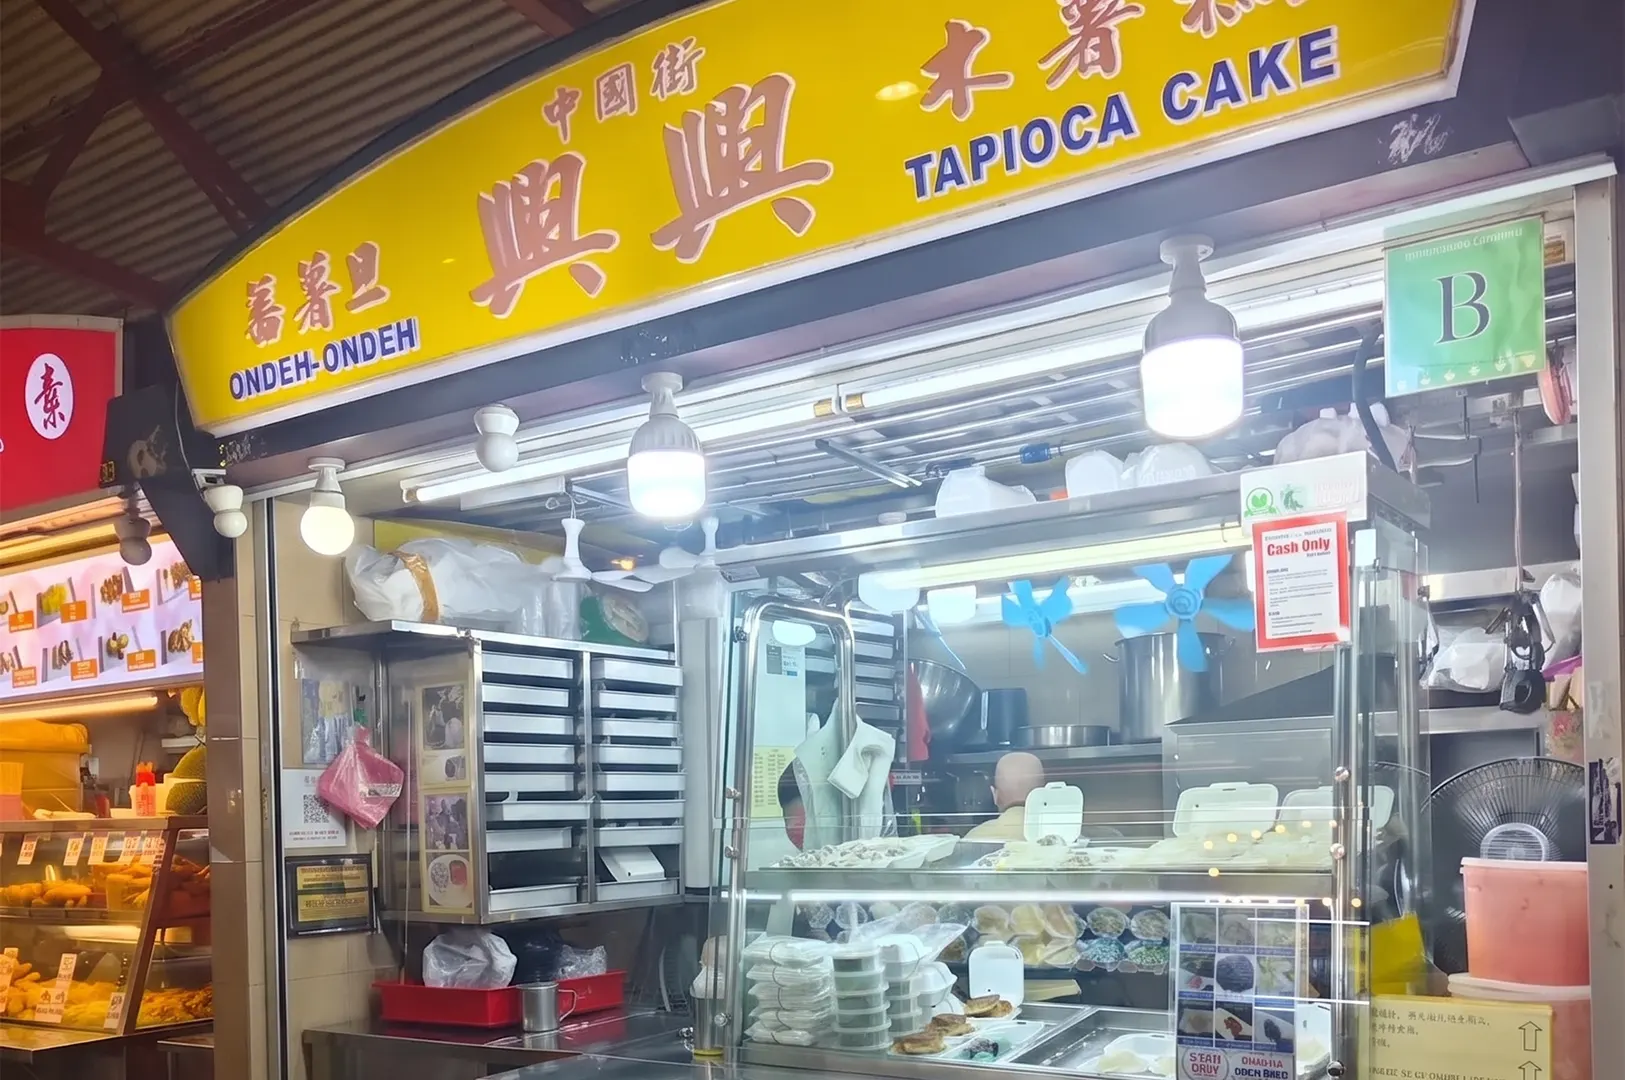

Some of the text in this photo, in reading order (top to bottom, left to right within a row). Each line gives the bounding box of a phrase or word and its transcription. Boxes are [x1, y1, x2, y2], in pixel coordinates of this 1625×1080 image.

[542, 36, 706, 144] 中國街
[904, 25, 1340, 201] TAPIOCA CAKE
[469, 73, 833, 319] 興興
[1435, 270, 1491, 346] B
[229, 316, 421, 401] ONDEH-ONDEH
[1267, 541, 1299, 557] Cash
[1302, 537, 1330, 552] Only
